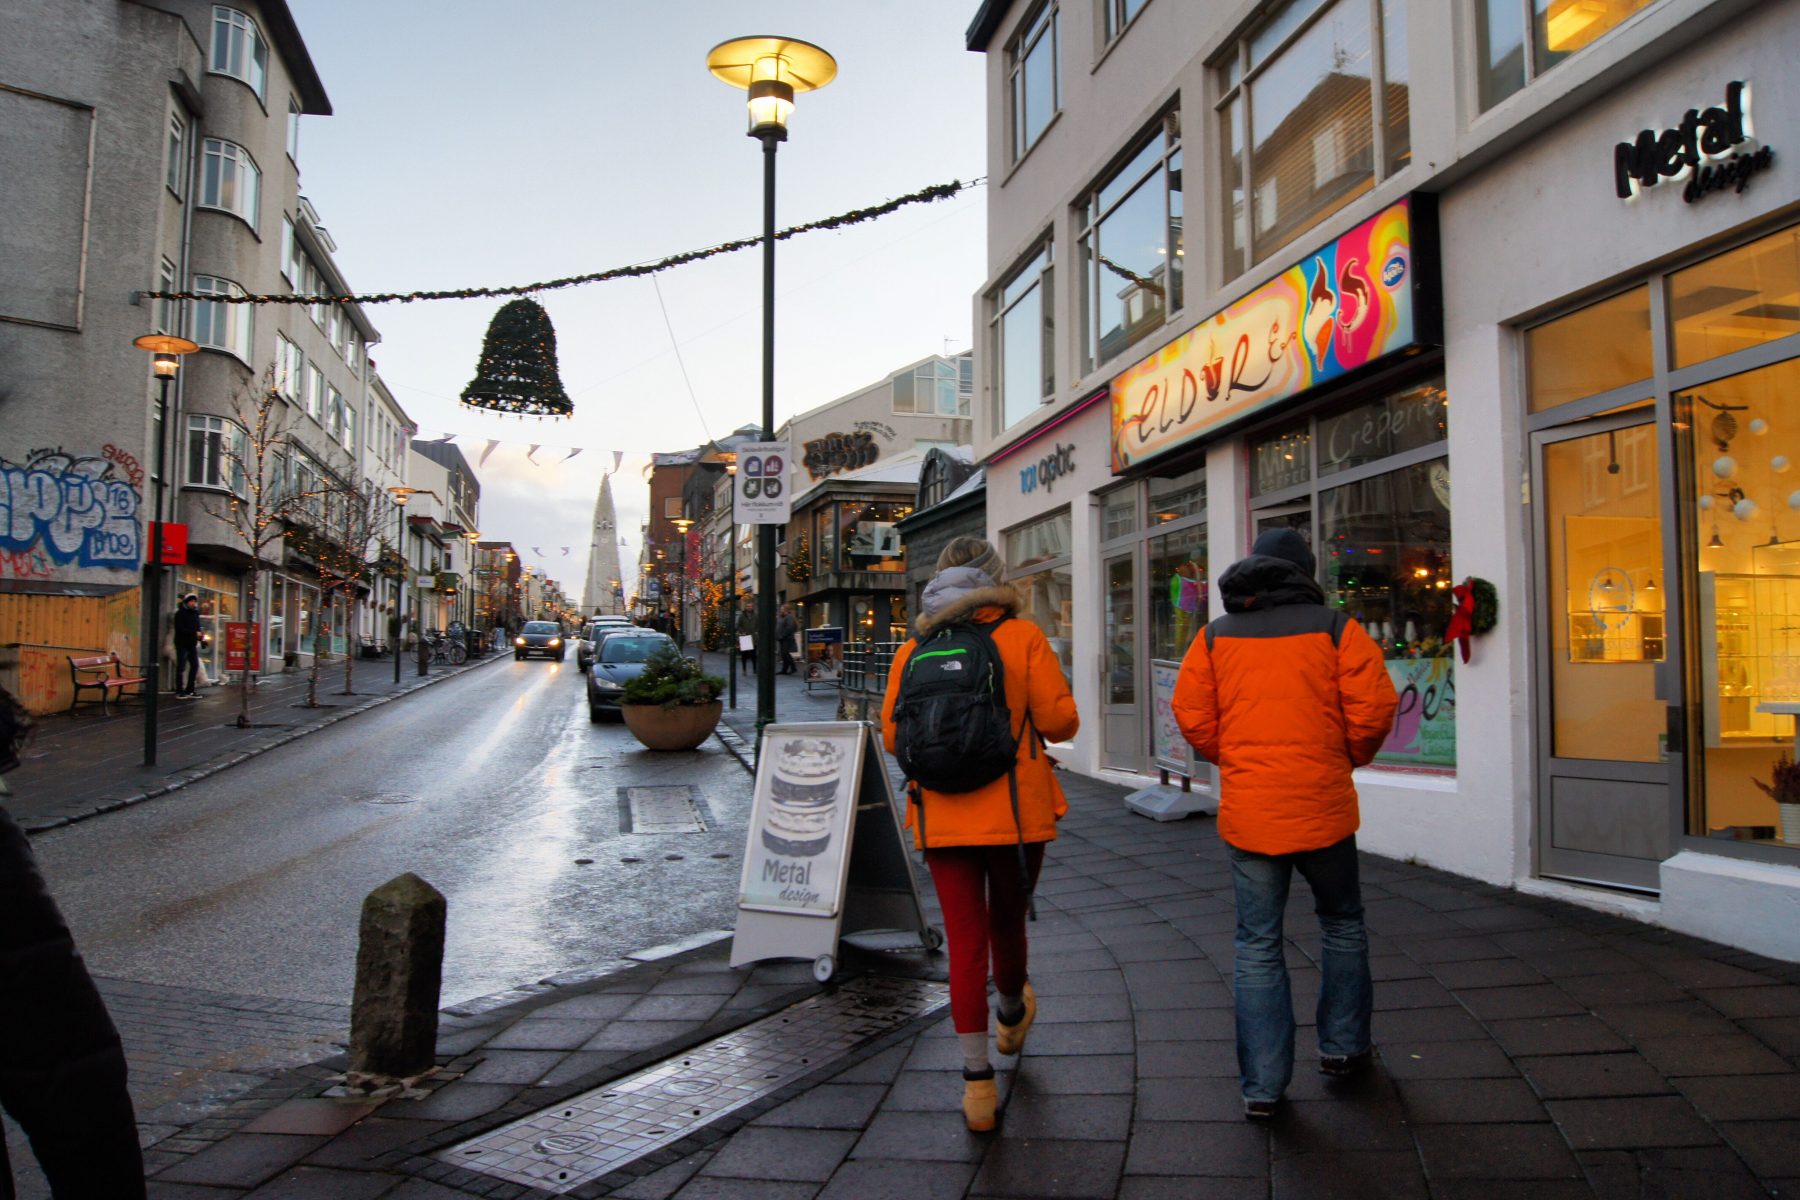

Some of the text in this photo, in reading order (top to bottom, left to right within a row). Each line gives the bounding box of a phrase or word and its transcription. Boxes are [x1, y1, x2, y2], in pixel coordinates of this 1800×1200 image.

[1614, 79, 1747, 200] Metal
[1683, 145, 1774, 203] design
[1019, 442, 1076, 495] 101 optic
[762, 859, 811, 885] Metal
[778, 887, 820, 908] design
